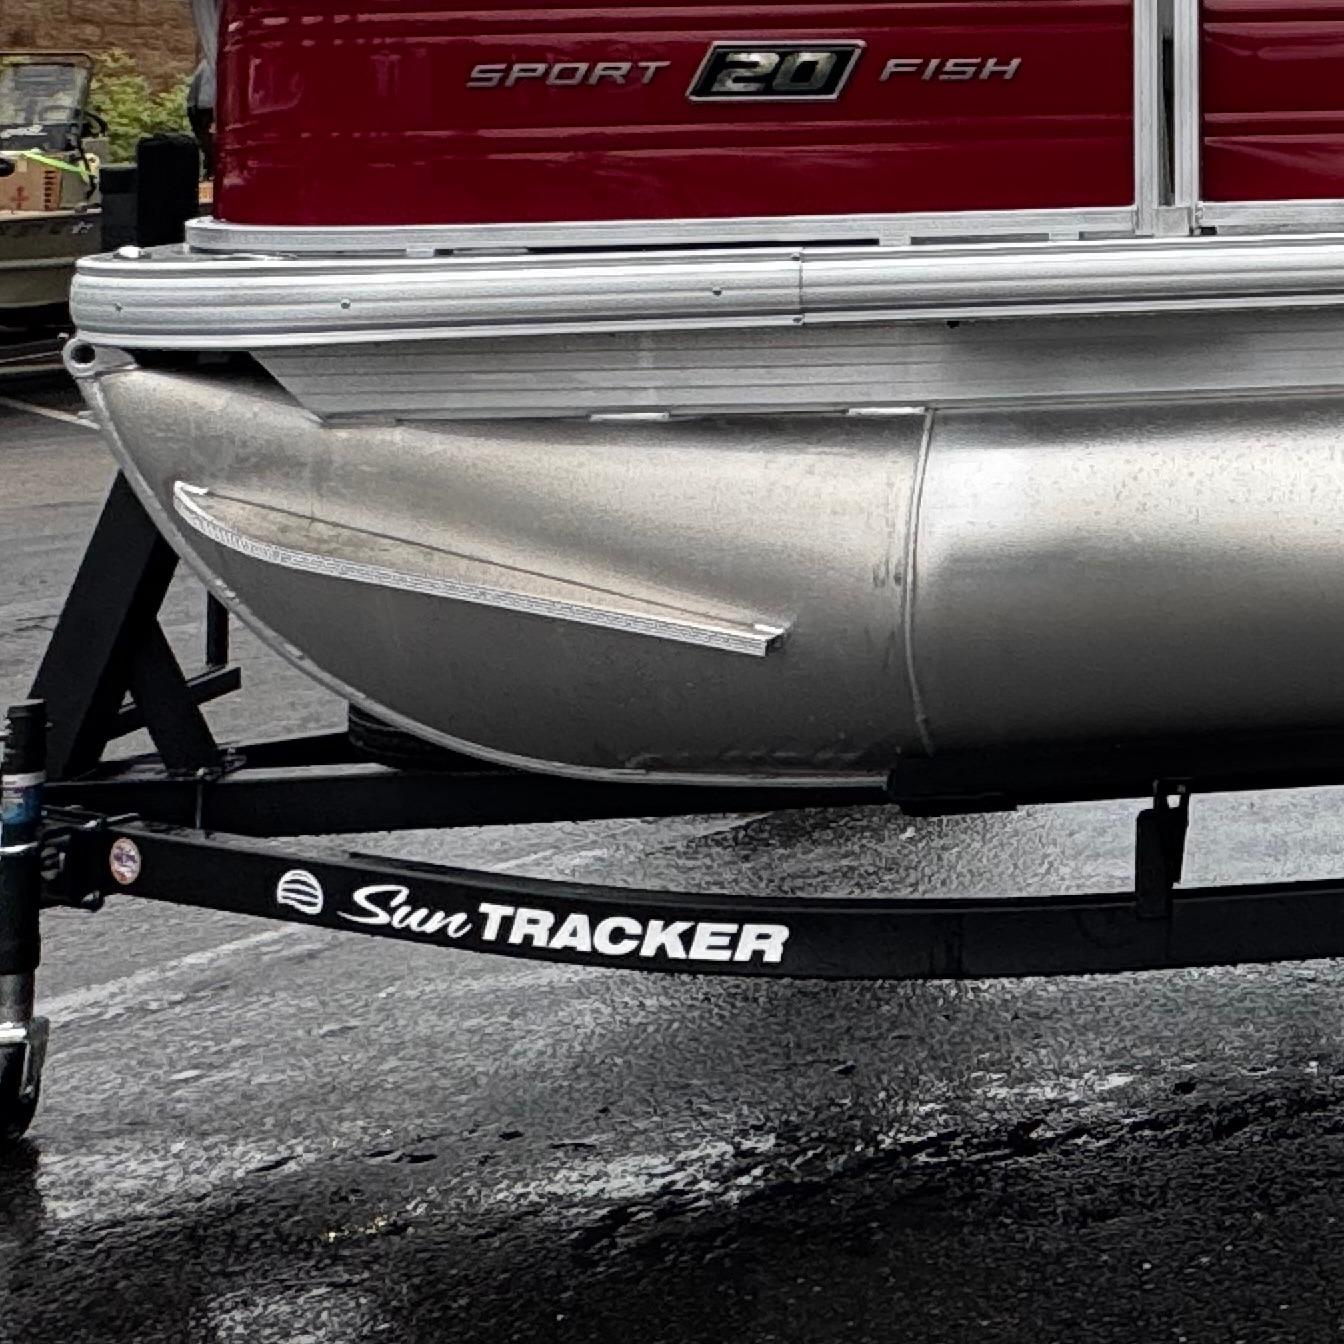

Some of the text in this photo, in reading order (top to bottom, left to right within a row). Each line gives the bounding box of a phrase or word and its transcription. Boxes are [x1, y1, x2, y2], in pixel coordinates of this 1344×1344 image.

[466, 51, 1022, 93] SPORT 20 FISH
[337, 884, 790, 964] Sun TRACKER
